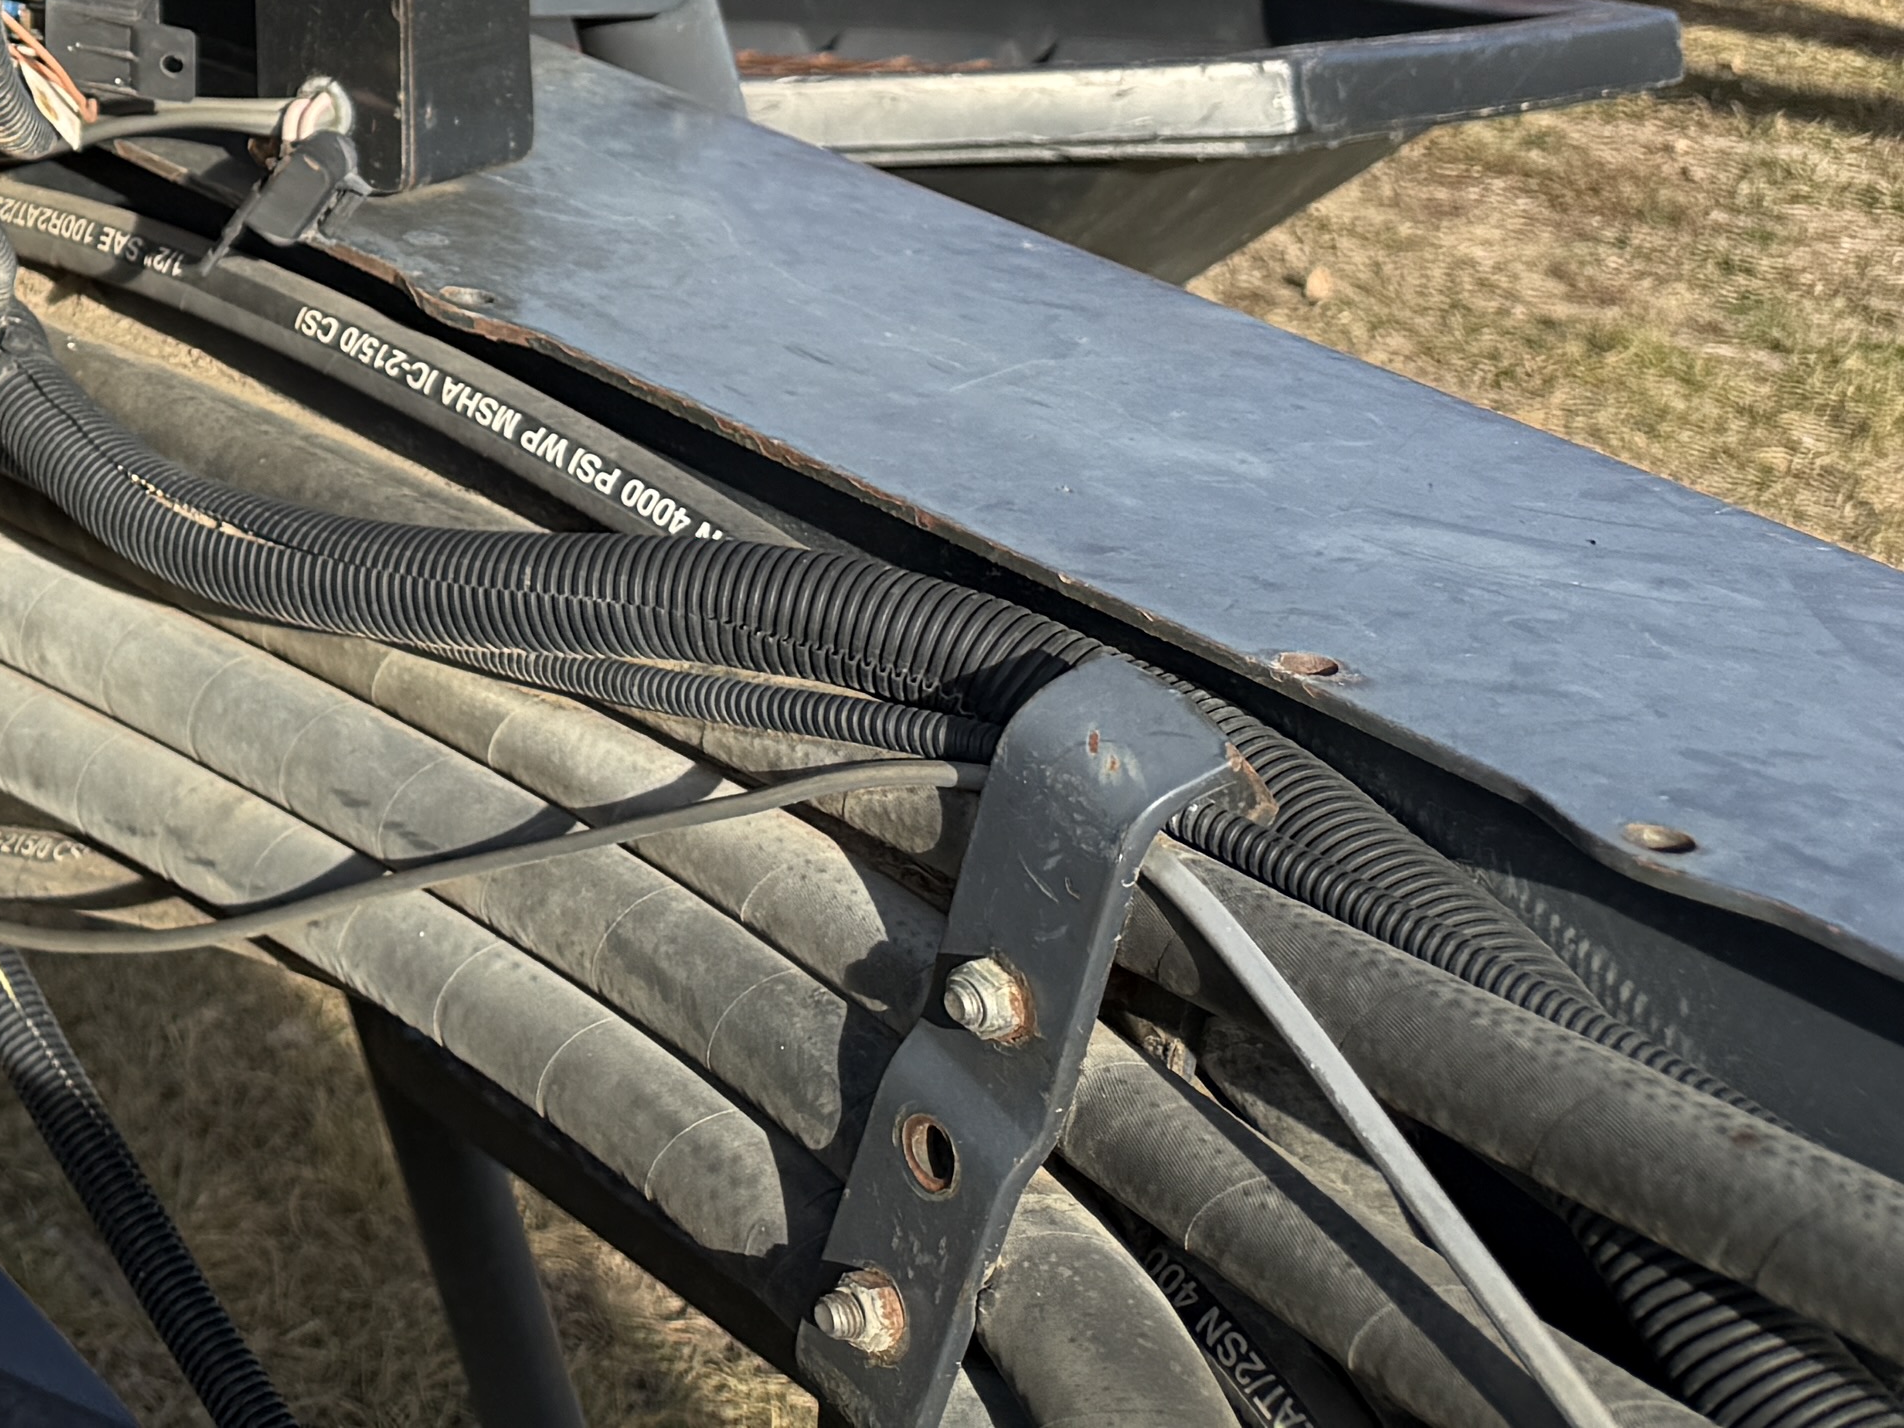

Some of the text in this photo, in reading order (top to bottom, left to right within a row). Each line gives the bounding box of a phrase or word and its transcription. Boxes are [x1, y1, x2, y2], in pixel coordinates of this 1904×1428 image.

[96, 226, 145, 262] SAE
[294, 306, 691, 535] 4000 PSI WP MSHA IC-215/0 CSI
[1194, 1305, 1315, 1428] AT/2SN
